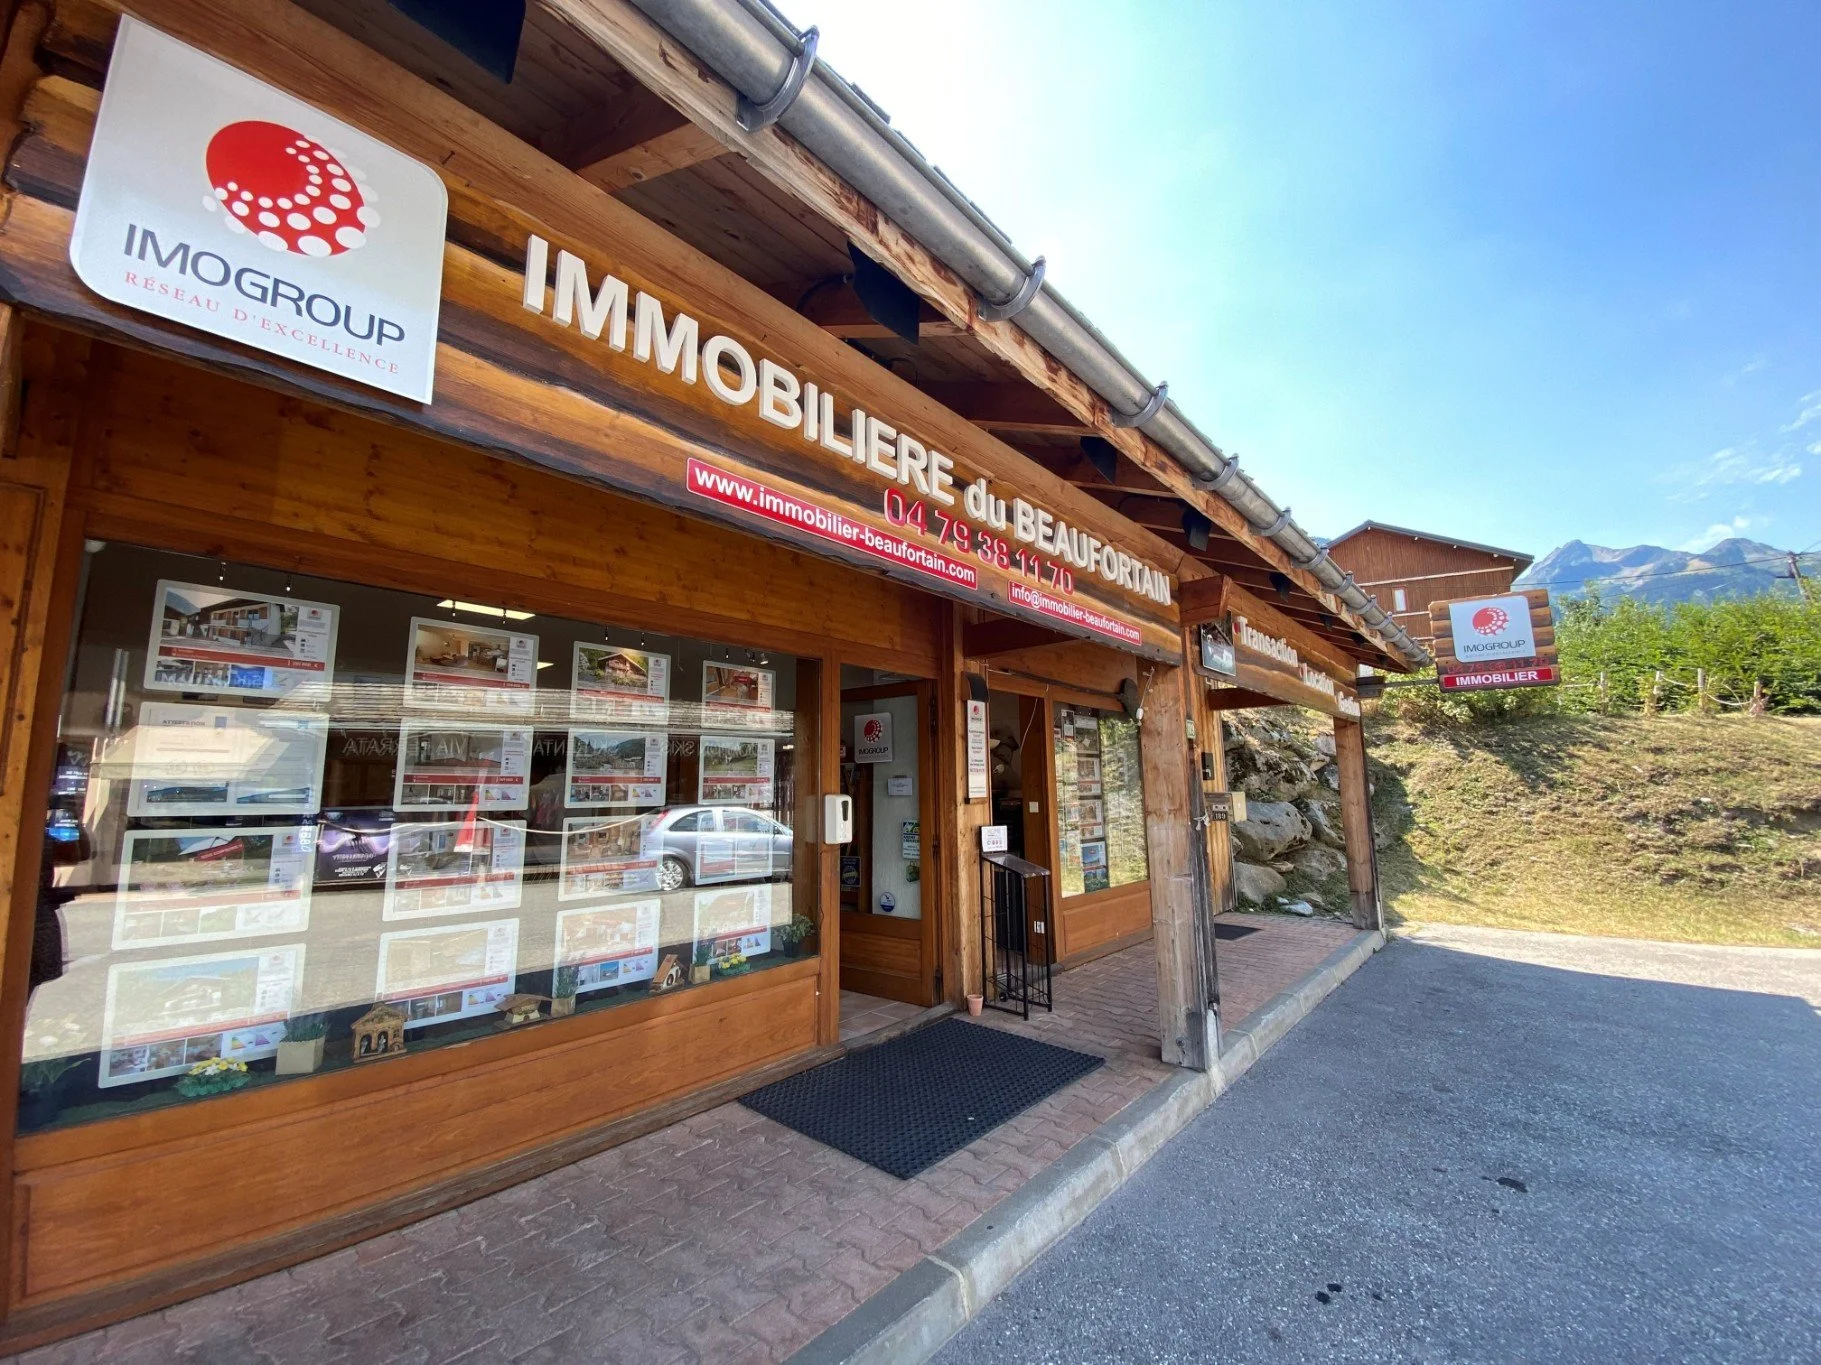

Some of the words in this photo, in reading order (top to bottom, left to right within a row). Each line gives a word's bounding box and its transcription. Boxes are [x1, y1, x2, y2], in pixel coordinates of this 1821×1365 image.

[124, 223, 405, 346] IMOGROUP
[125, 271, 220, 313] RÉSEAU
[233, 308, 399, 374] D'EXCELLENCE
[523, 234, 955, 505] IMMOBILIERE
[963, 478, 1006, 531] du
[1012, 497, 1172, 606] BEAUFORTAIN
[694, 467, 976, 584] www.immobilier-beaufortain.com
[884, 487, 928, 537] 04
[935, 510, 972, 554] 79
[977, 531, 1011, 571] 38
[1015, 548, 1043, 584] 11
[1047, 560, 1075, 596] 70
[1011, 582, 1141, 643] info@immobilier-beaufortain.com
[1238, 616, 1298, 667] Transaction
[1463, 639, 1526, 654] IMOGROUP
[1455, 670, 1540, 687] IMMOBILIER
